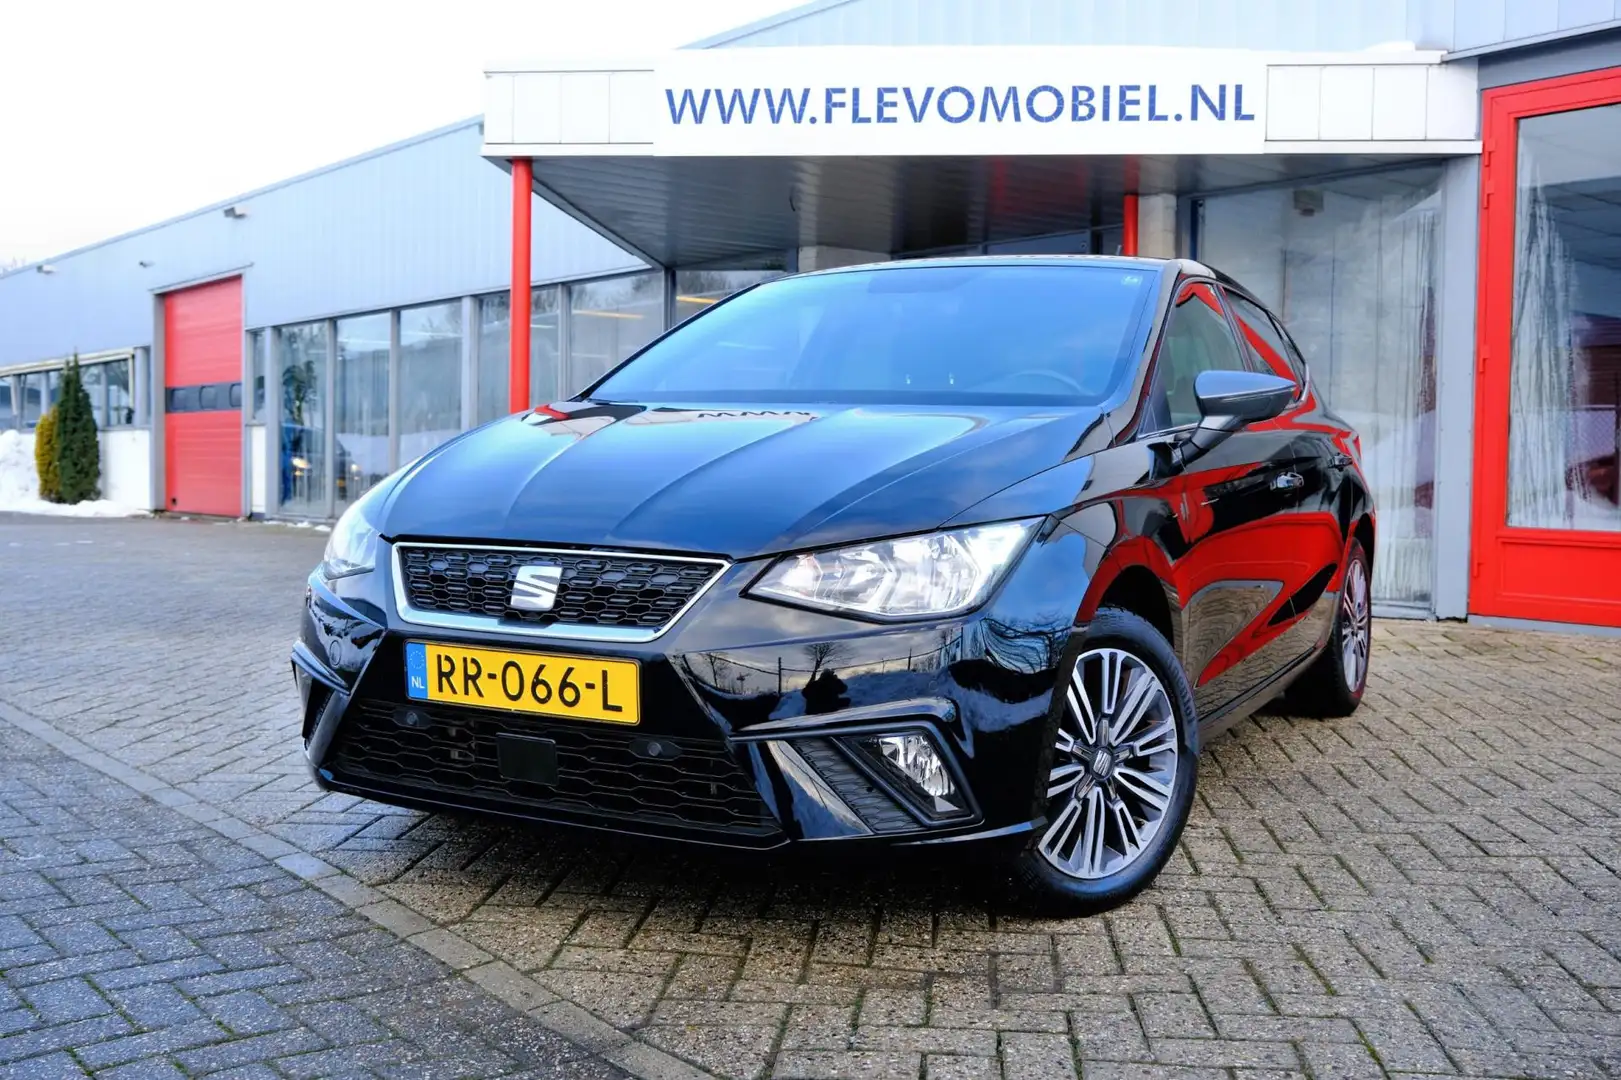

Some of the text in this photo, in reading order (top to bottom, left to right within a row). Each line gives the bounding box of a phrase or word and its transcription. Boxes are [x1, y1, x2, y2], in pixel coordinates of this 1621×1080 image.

[665, 84, 1255, 124] WWW.FLEVOMOBIEL.NL
[411, 676, 425, 690] NL
[436, 654, 623, 713] RR-066-L
